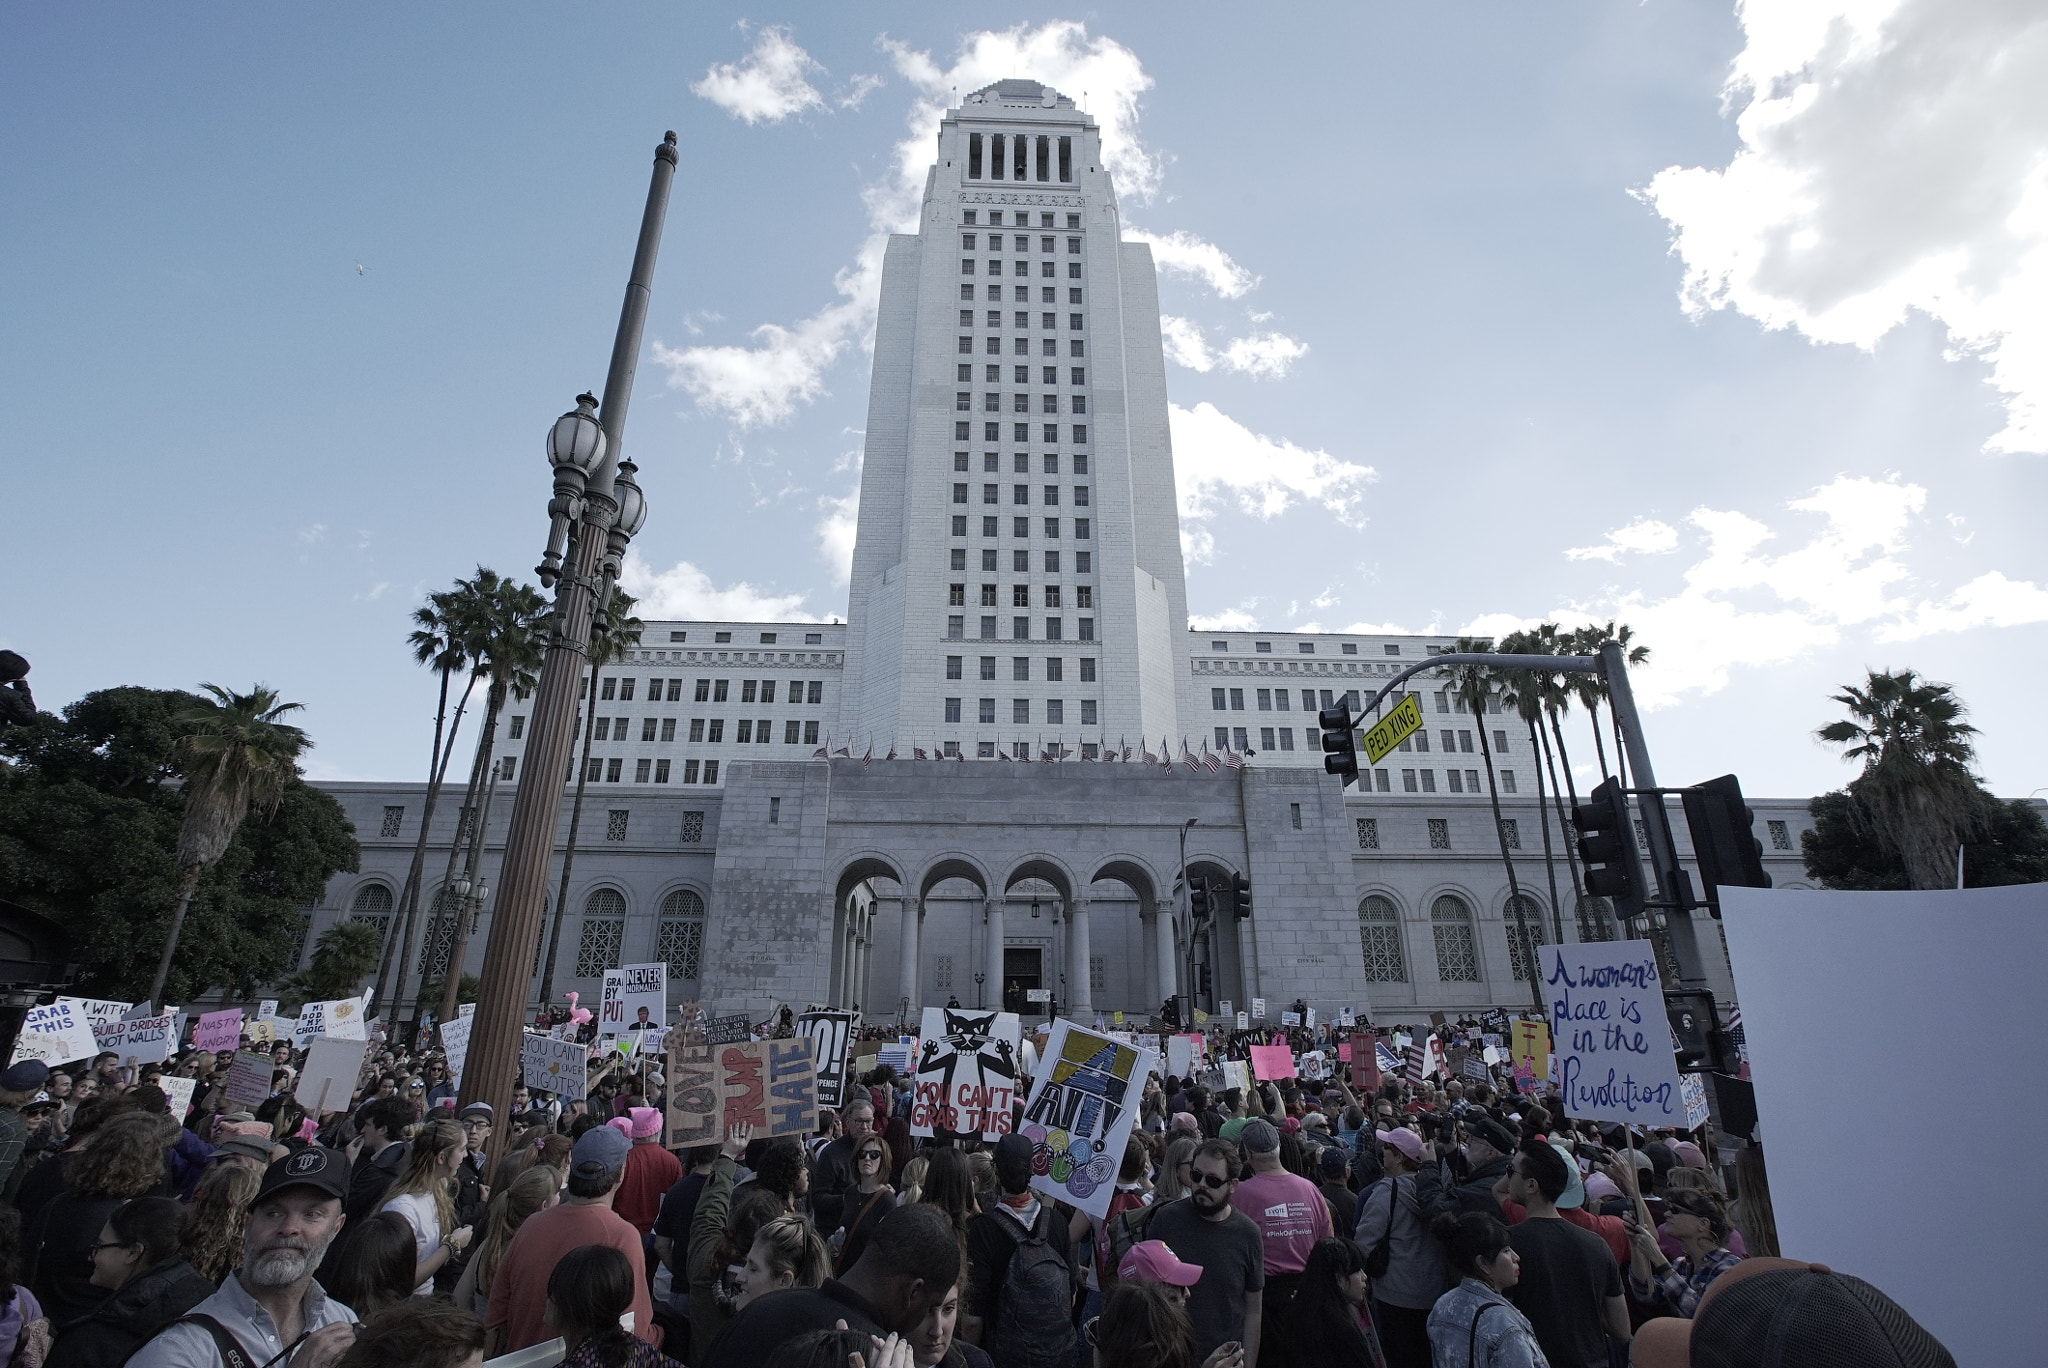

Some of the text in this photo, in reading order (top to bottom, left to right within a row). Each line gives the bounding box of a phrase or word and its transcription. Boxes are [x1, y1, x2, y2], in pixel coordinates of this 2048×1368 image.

[1368, 704, 1415, 757] PED XING
[626, 968, 661, 985] NEVER
[1547, 949, 1658, 989] A woman's
[606, 977, 624, 987] GRA
[626, 982, 661, 993] NORMALIZE
[605, 987, 618, 999] BY
[26, 1004, 71, 1022] GRAB
[93, 1003, 129, 1015] WITH
[301, 1012, 325, 1020] BOD
[1483, 1008, 1499, 1020] see?
[1553, 988, 1642, 1035] place is
[29, 1017, 75, 1034] THIS
[93, 1015, 171, 1037] BUILD BRIDGES
[201, 1016, 239, 1031] NASTY
[714, 1016, 730, 1025] YOU
[730, 1013, 750, 1023] LOVE
[733, 1021, 744, 1029] SO
[1488, 1014, 1505, 1026] bad.
[96, 1028, 166, 1047] NOT WALLS
[296, 1026, 326, 1035] CHOIC
[1572, 1022, 1648, 1054] in the
[200, 1034, 238, 1049] ANGRY
[524, 1035, 548, 1055] YOU
[1234, 1033, 1261, 1050] VIVA
[523, 1055, 585, 1076] COMB OVER
[525, 1068, 585, 1098] BIGOTRY
[769, 1037, 815, 1136] HATE
[1562, 1056, 1673, 1115] Revolution
[672, 1044, 718, 1145] LOVE
[915, 1080, 1013, 1109] YOU CAN'T
[911, 1103, 1012, 1135] GRAB THIS
[1271, 1207, 1285, 1215] VOTE
